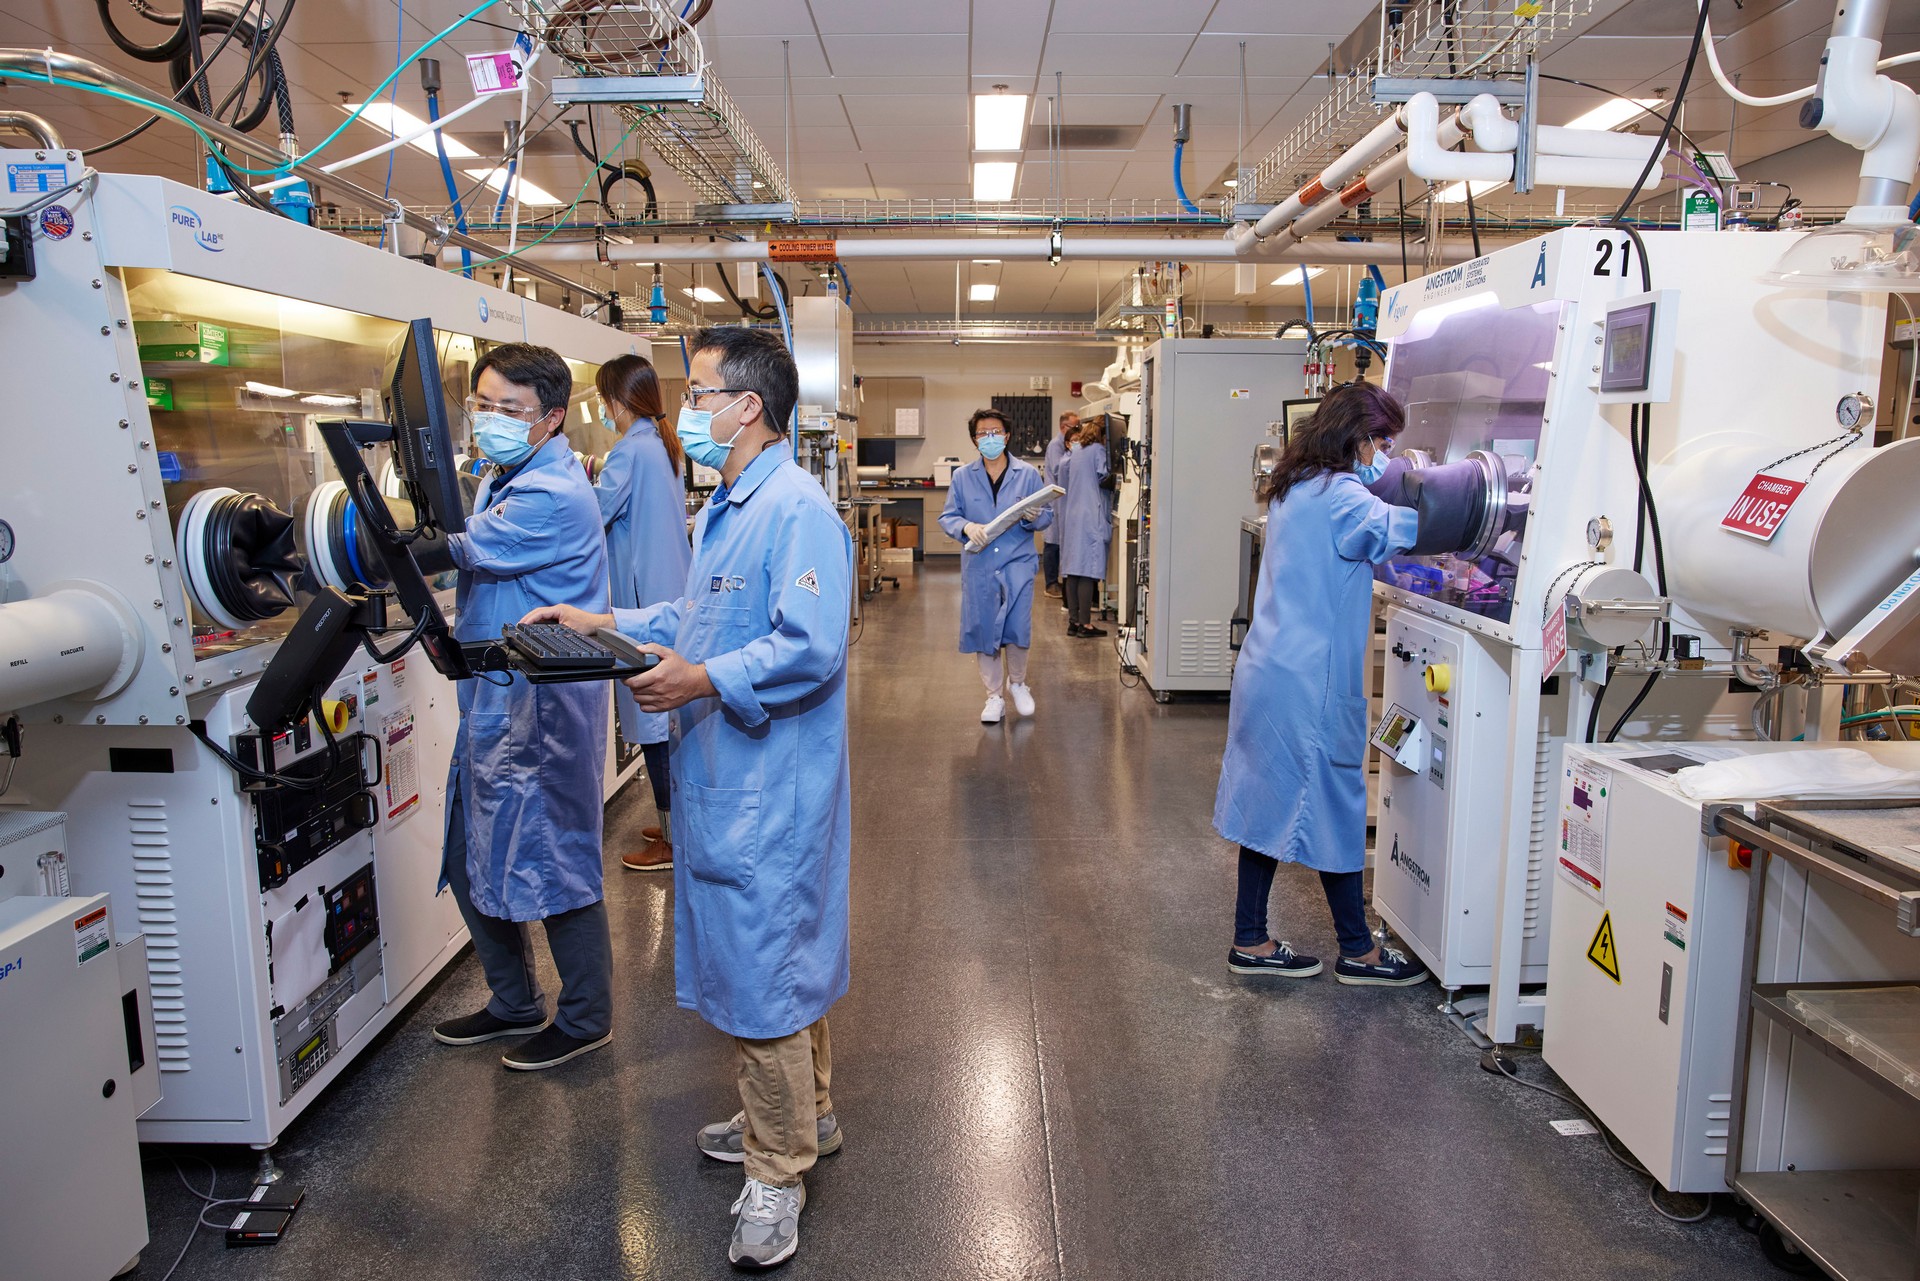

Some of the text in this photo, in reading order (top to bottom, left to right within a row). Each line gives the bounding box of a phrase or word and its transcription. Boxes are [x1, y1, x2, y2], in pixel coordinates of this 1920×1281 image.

[172, 212, 195, 228] PURE
[202, 230, 218, 244] LAB
[779, 243, 833, 252] COOLING TOWER WATER
[1467, 256, 1490, 271] INTEGRATED
[1594, 238, 1630, 277] 21
[1424, 266, 1463, 292] ANGSTROM
[1465, 276, 1486, 289] SOLUTIONS
[1423, 283, 1462, 302] ENGINEERING
[1388, 290, 1408, 323] Vigor
[1757, 480, 1793, 496] CHAMBER
[1728, 495, 1788, 530] IN USE
[1879, 598, 1898, 610] Do
[1892, 583, 1916, 598] Not
[60, 646, 84, 656] EVACUATE
[1550, 624, 1564, 662] USE
[10, 659, 28, 667] REFILL
[1400, 851, 1430, 888] ANGSTROM
